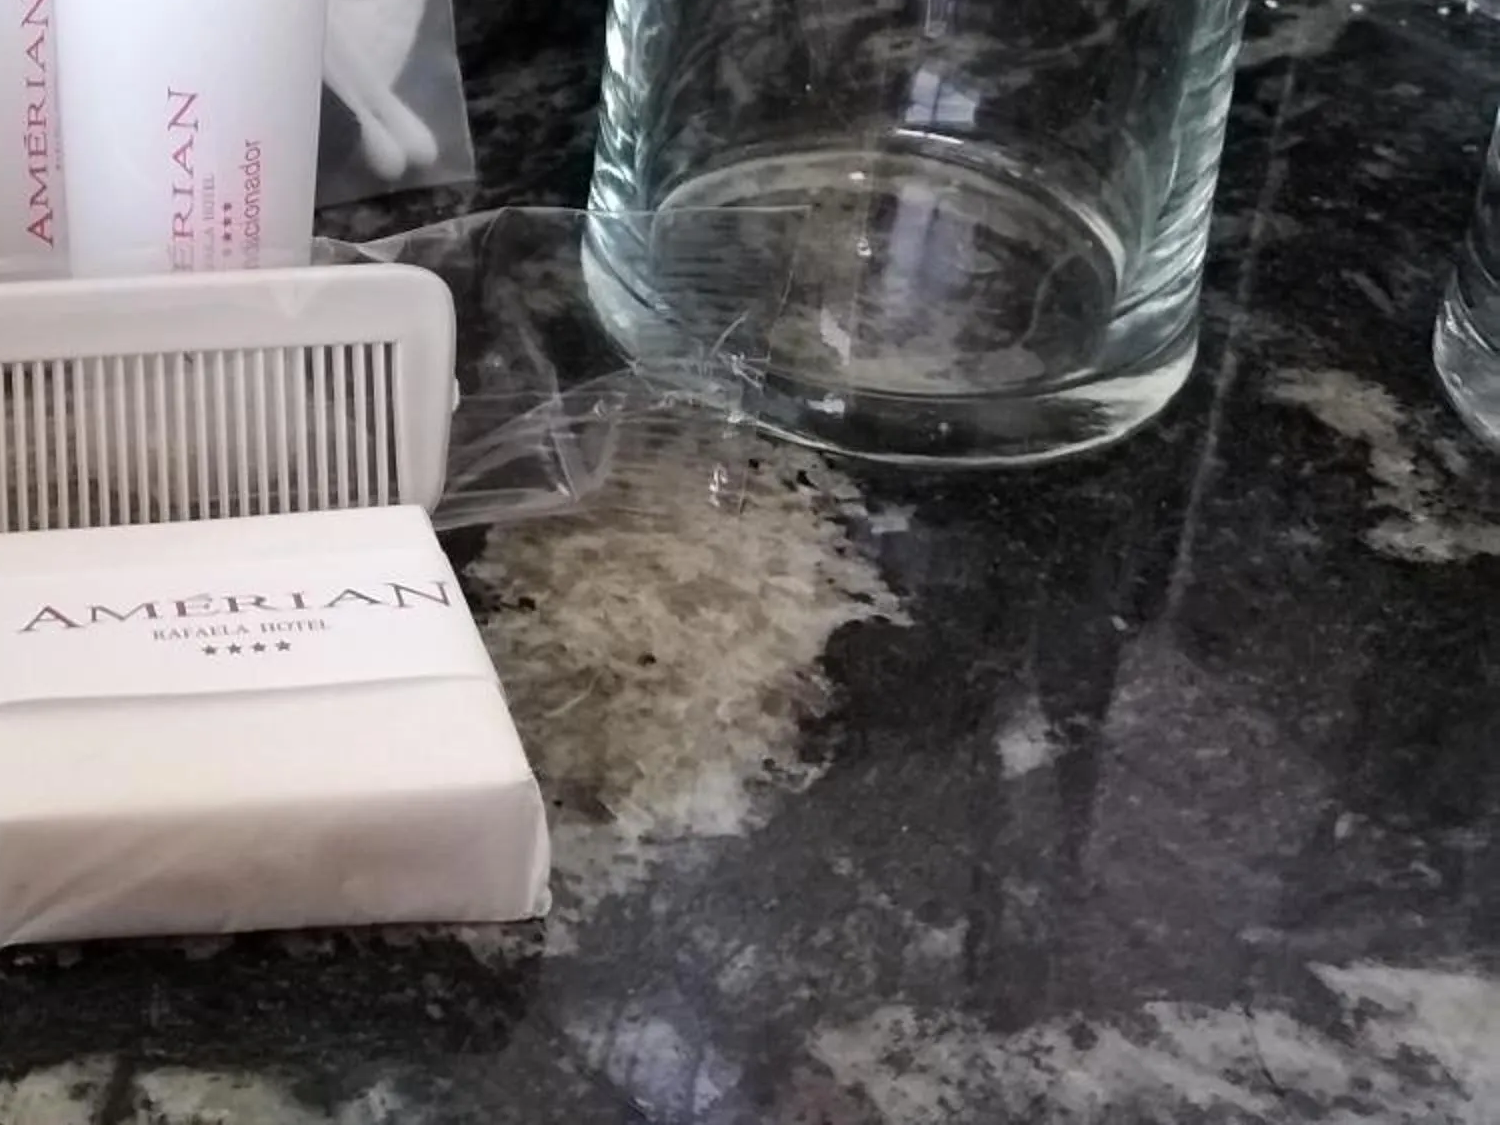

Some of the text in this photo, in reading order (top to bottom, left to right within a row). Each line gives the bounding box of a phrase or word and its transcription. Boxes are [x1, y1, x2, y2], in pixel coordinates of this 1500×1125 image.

[167, 86, 200, 272] ÉRIAN
[152, 618, 329, 642] RAFAELA HOTEL
